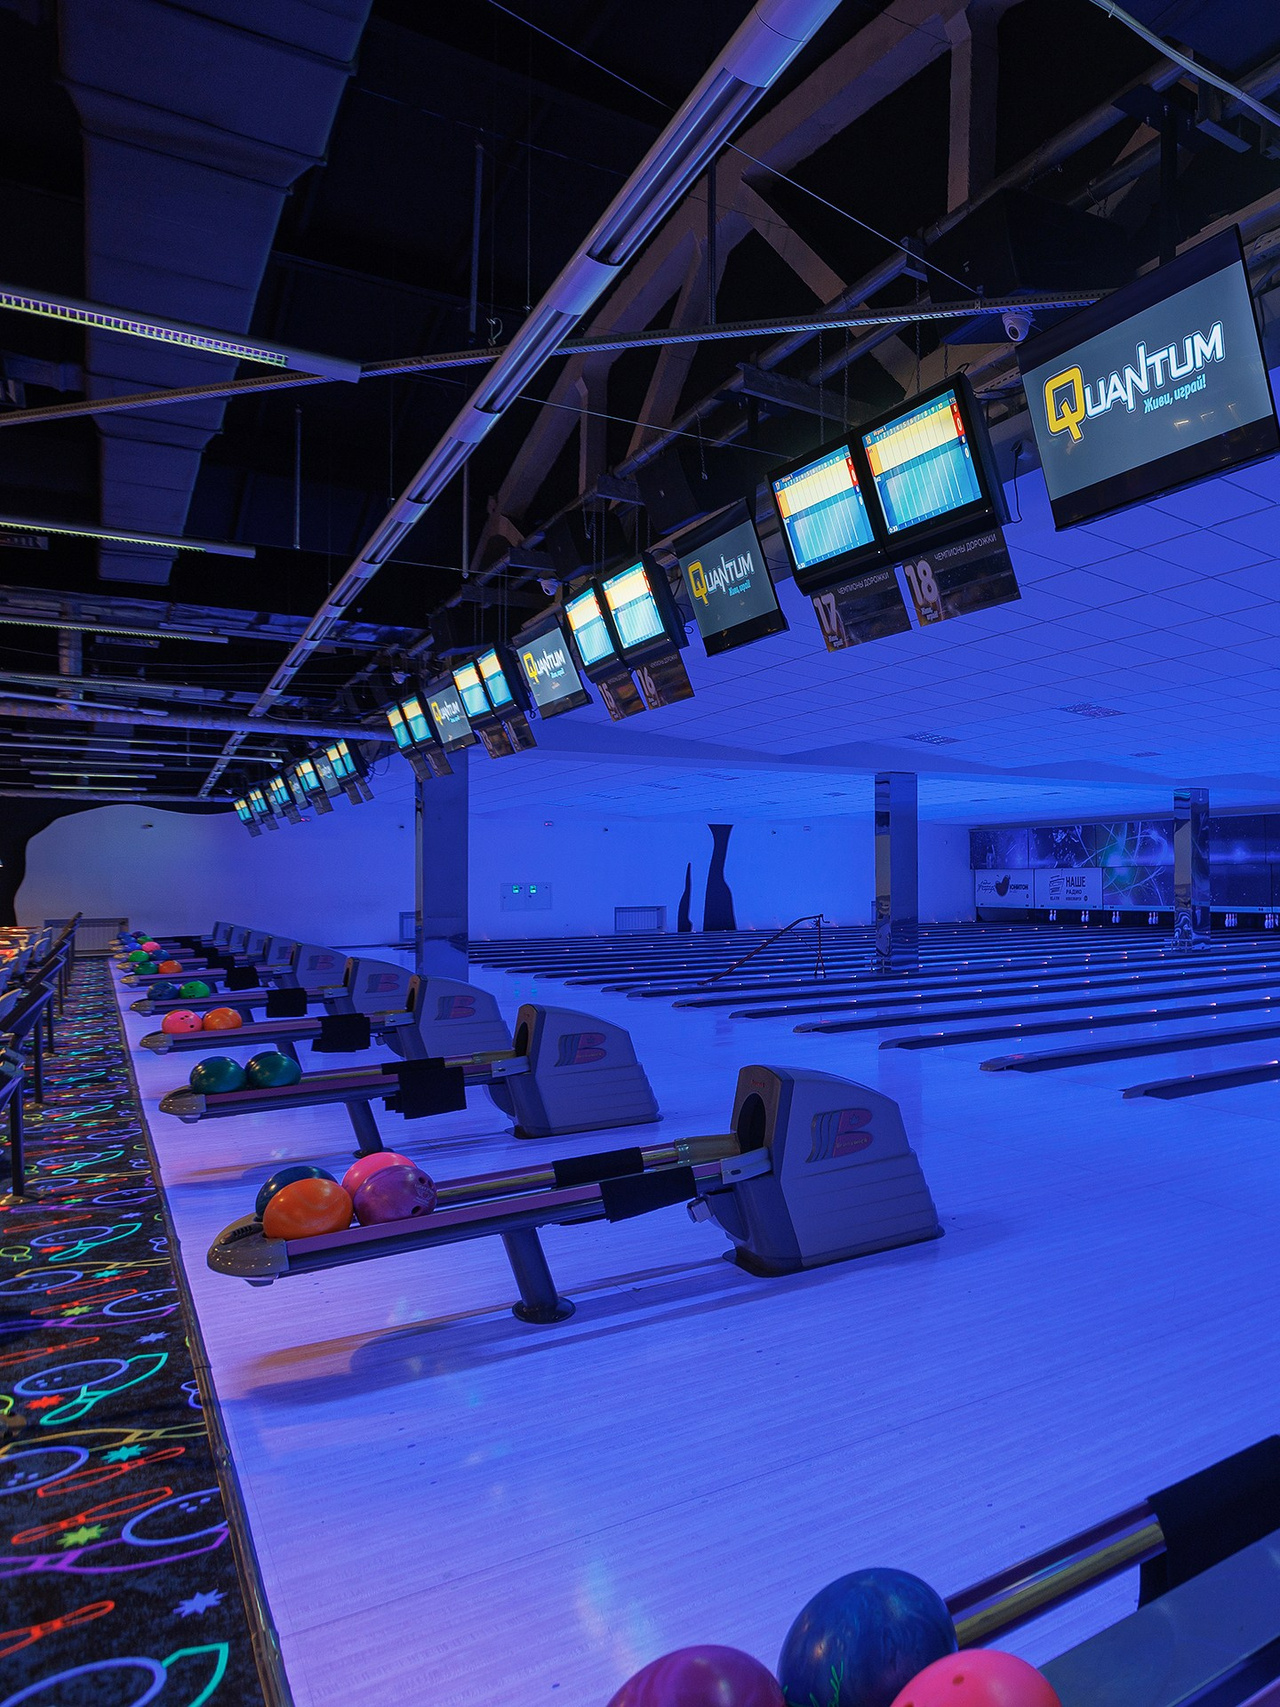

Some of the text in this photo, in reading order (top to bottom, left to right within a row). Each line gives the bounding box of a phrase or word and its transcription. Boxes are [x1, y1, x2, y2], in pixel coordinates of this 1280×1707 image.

[1044, 321, 1226, 443] QUANTUM
[1143, 375, 1207, 414] Живи, играй!
[966, 533, 997, 552] ДОРОЖКИ
[687, 550, 755, 607] QUANTUM
[904, 559, 938, 606] 18
[813, 592, 838, 634] 17
[1066, 876, 1086, 887] НАШЕ
